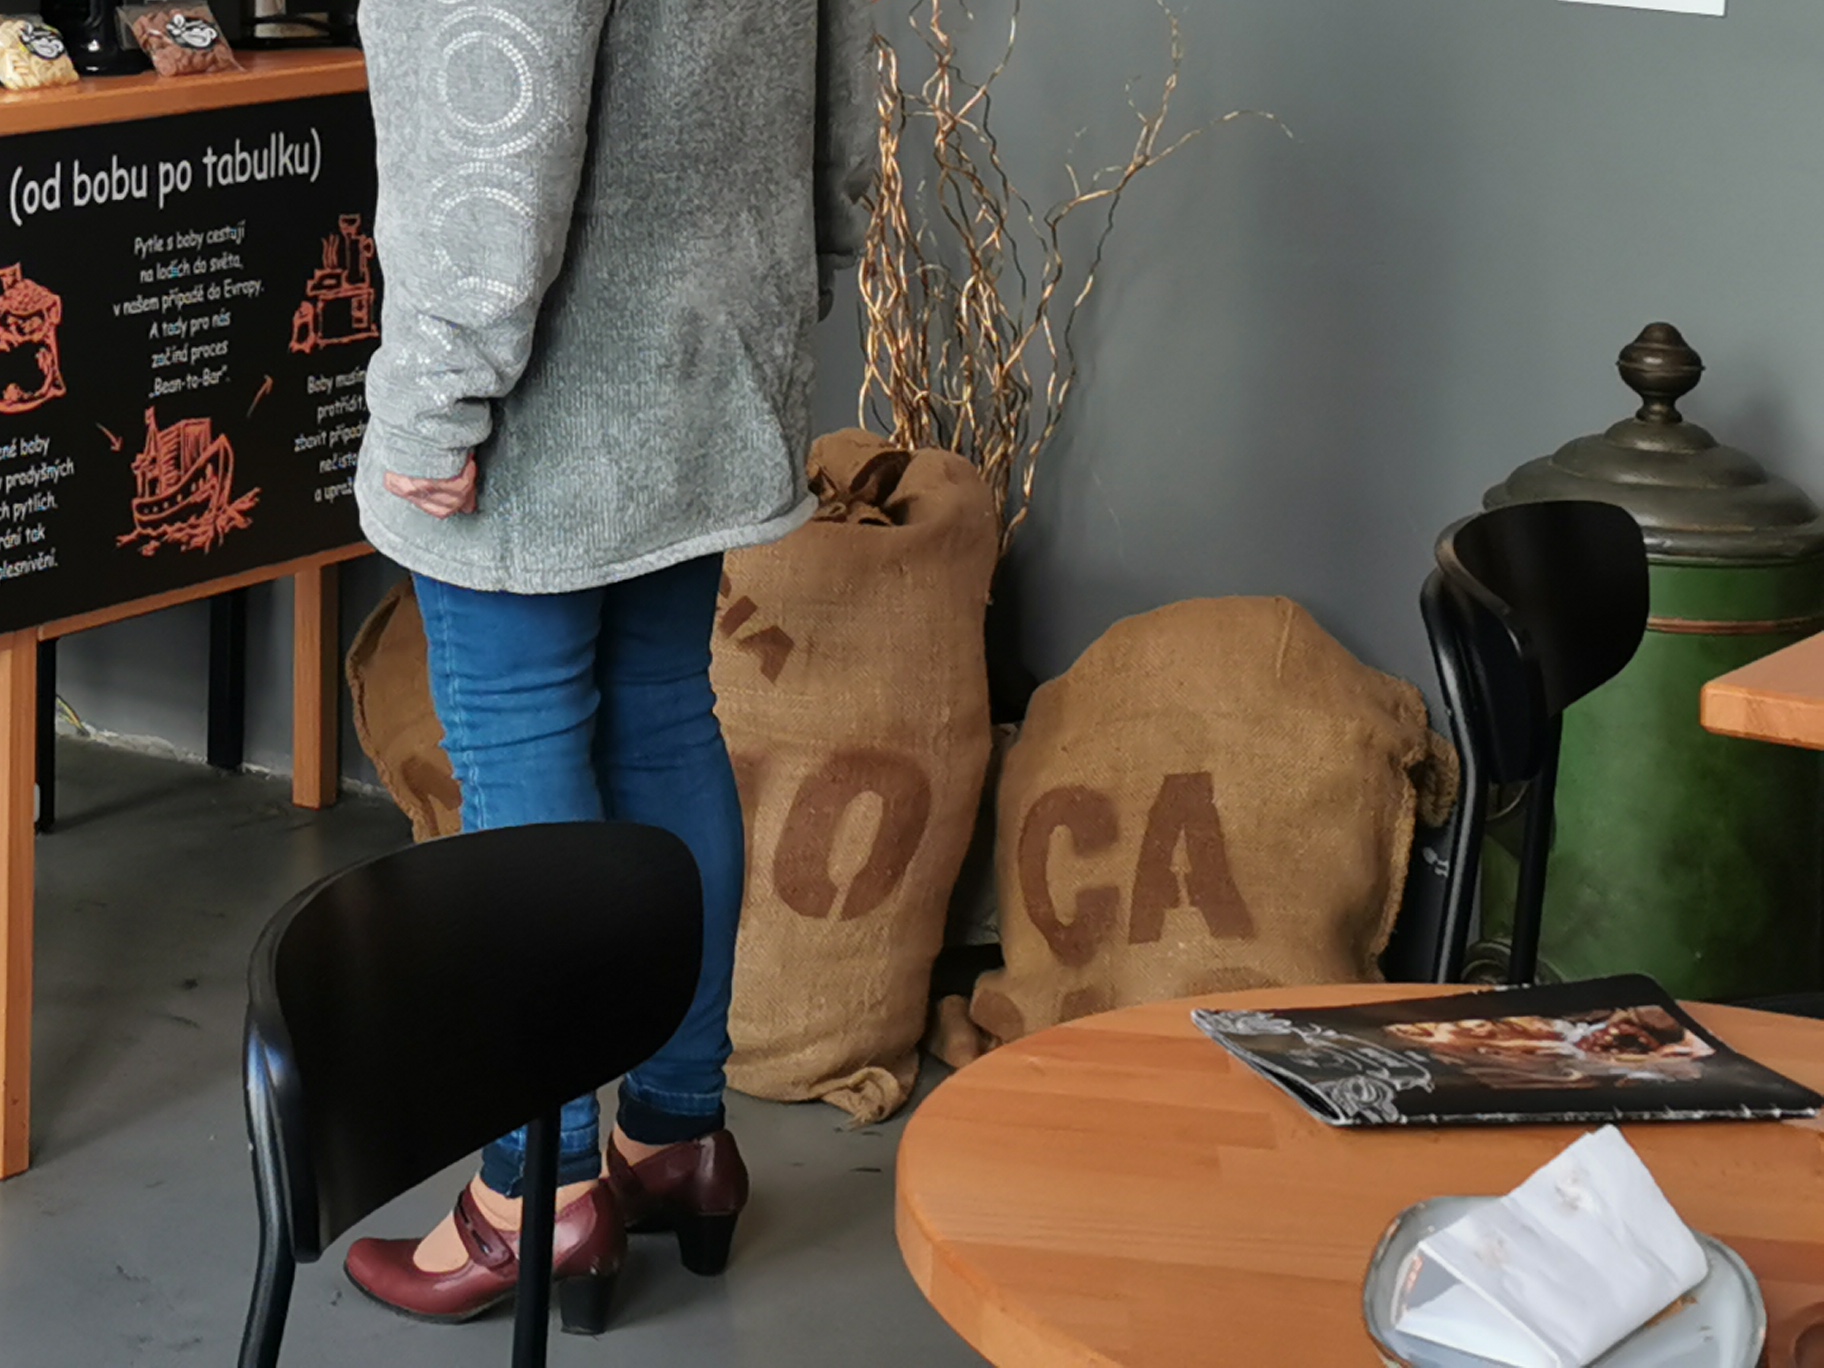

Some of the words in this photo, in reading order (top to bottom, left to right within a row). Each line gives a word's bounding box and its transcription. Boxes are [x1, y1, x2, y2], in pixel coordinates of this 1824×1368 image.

[9, 165, 62, 227] (od
[74, 158, 147, 205] bobu
[158, 160, 191, 210] po
[202, 128, 322, 188] tabulku)
[134, 234, 164, 260] Pytle
[166, 235, 174, 251] s
[176, 229, 205, 251] boby
[206, 219, 246, 245] cestují
[140, 267, 154, 283] na
[193, 256, 207, 274] do
[113, 303, 121, 317] v
[123, 294, 159, 315] našem
[207, 282, 221, 300] do
[149, 322, 160, 340] A
[162, 316, 187, 339] tady
[190, 317, 210, 338] pro
[212, 307, 232, 327] nás
[151, 343, 189, 369] začíná
[191, 339, 229, 366] proces
[307, 374, 334, 394] Boby
[20, 434, 50, 457] boby
[5, 457, 75, 494] prodyšných
[314, 488, 322, 502] a
[25, 523, 46, 542] tak
